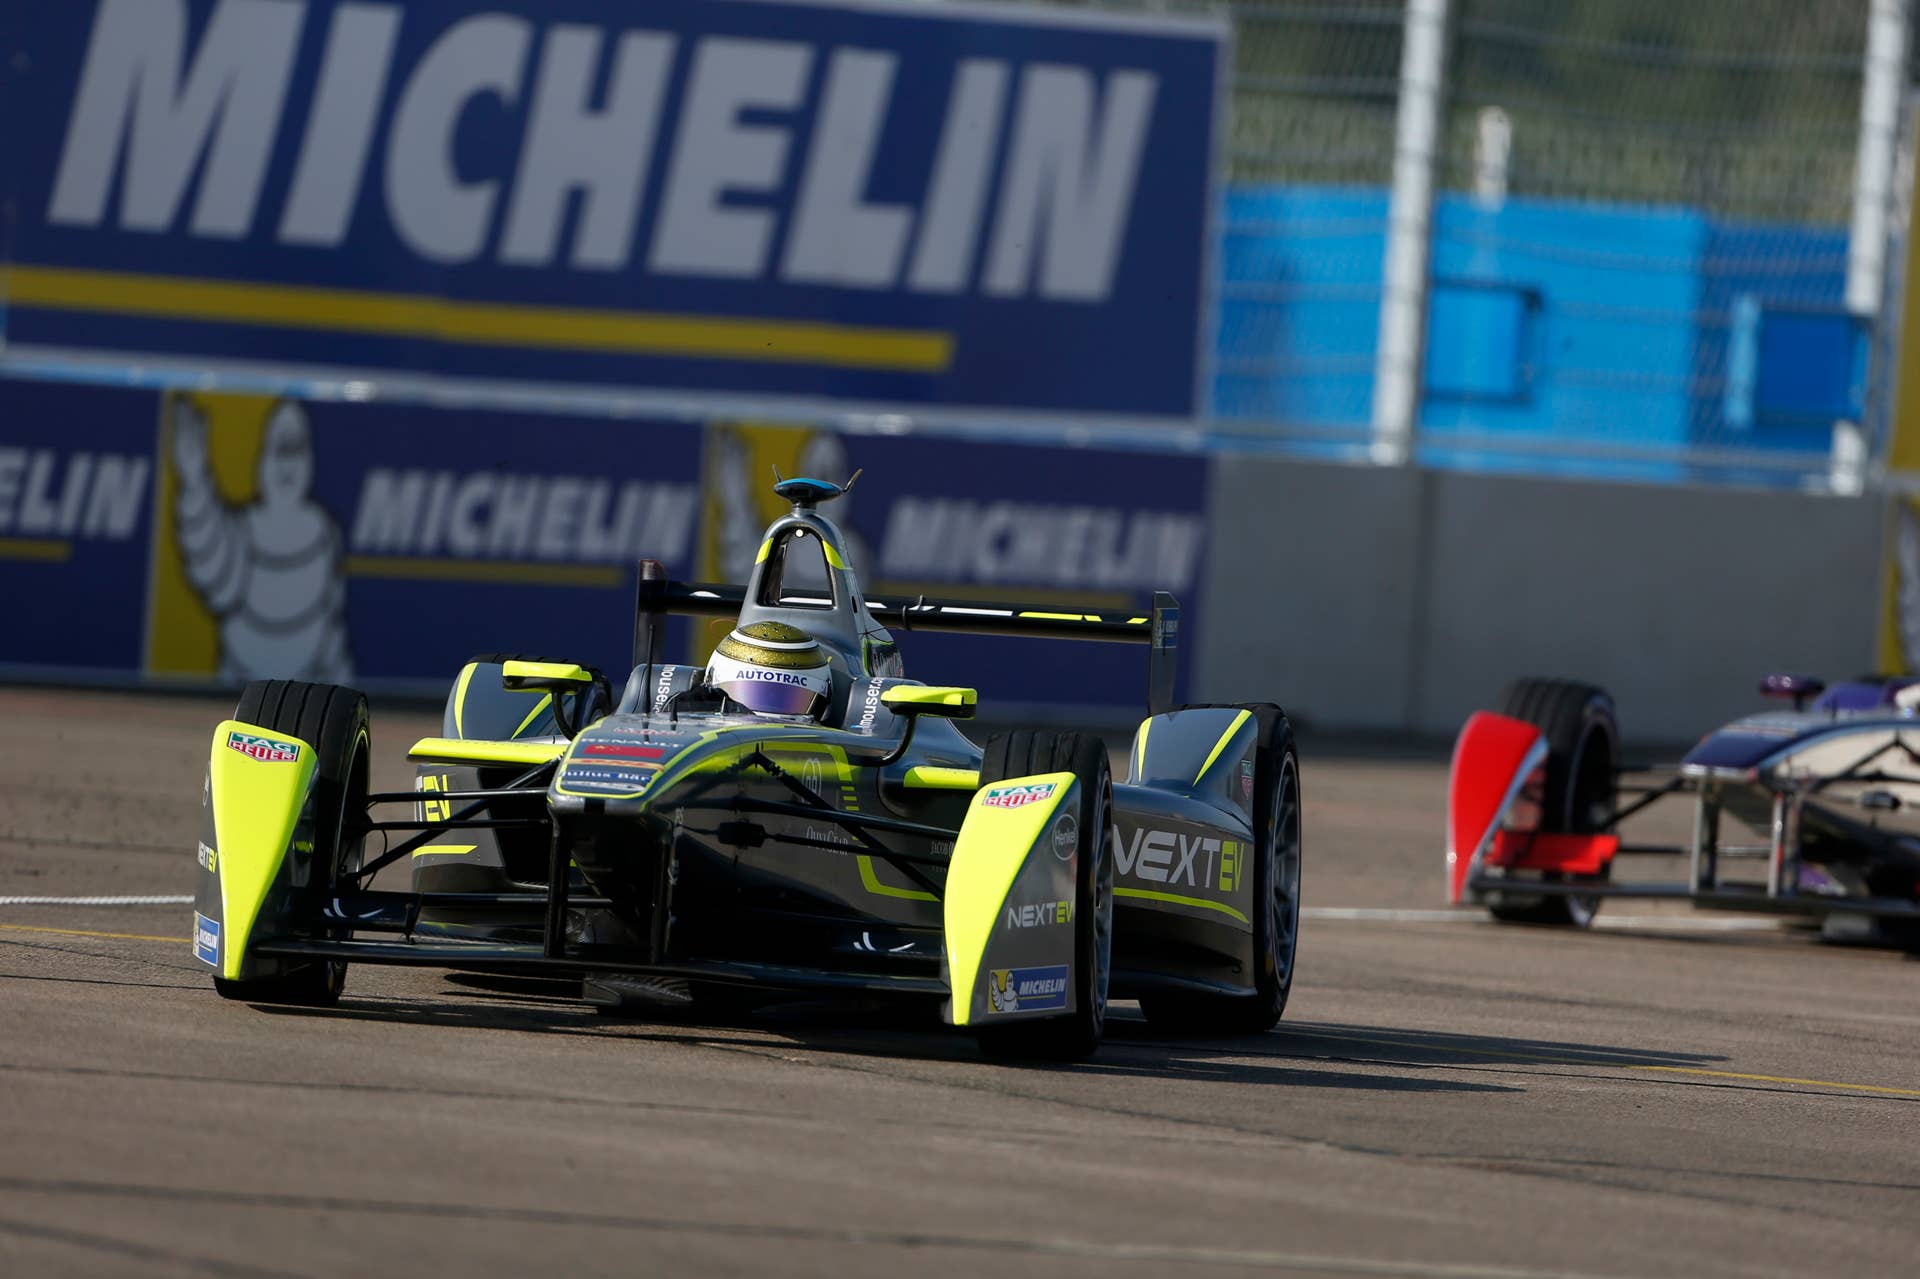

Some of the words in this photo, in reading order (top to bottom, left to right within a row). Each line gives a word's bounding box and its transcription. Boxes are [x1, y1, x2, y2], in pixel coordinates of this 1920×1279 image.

[46, 0, 1160, 303] MICHELIN
[351, 467, 698, 562] MICHELIN
[880, 496, 1199, 592] MICHELIN
[736, 670, 808, 687] AUTOTRAC
[229, 741, 296, 761] HEUER
[236, 734, 292, 752] TAG
[991, 783, 1049, 797] TAG
[985, 793, 1050, 808] HEUER
[1007, 901, 1074, 930] NEXTEV
[1019, 978, 1066, 996] MICHELIN
